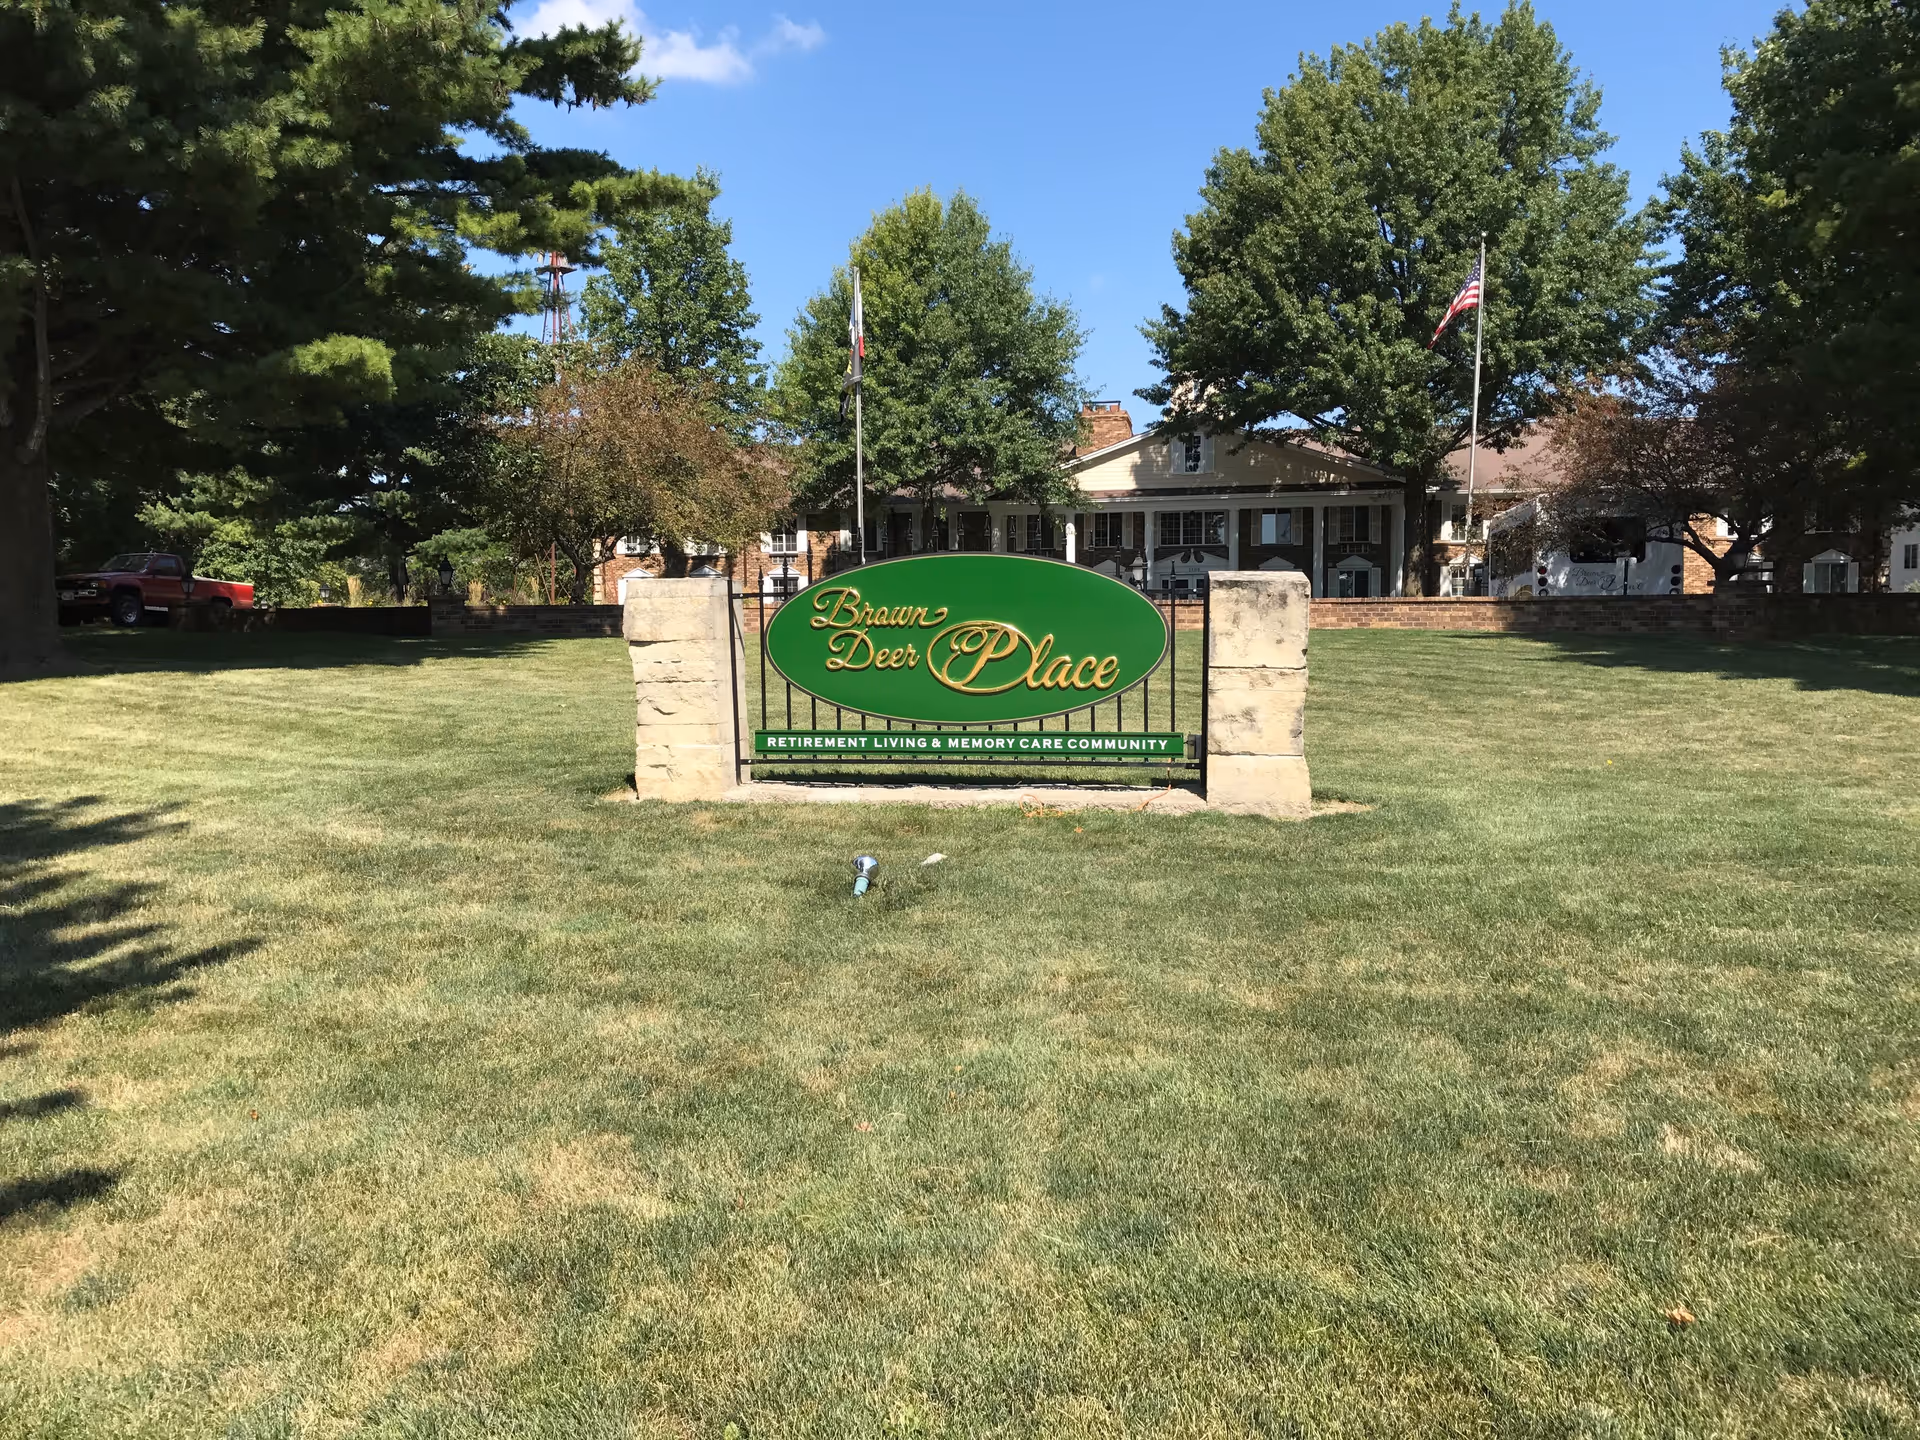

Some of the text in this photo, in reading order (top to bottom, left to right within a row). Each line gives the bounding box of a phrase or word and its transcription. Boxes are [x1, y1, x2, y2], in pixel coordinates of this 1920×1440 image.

[810, 587, 948, 628] Brown
[826, 620, 1120, 693] Deer Place
[767, 737, 1168, 750] RETIREMENT LIVING & MEMORY CARE COMMUNITY
